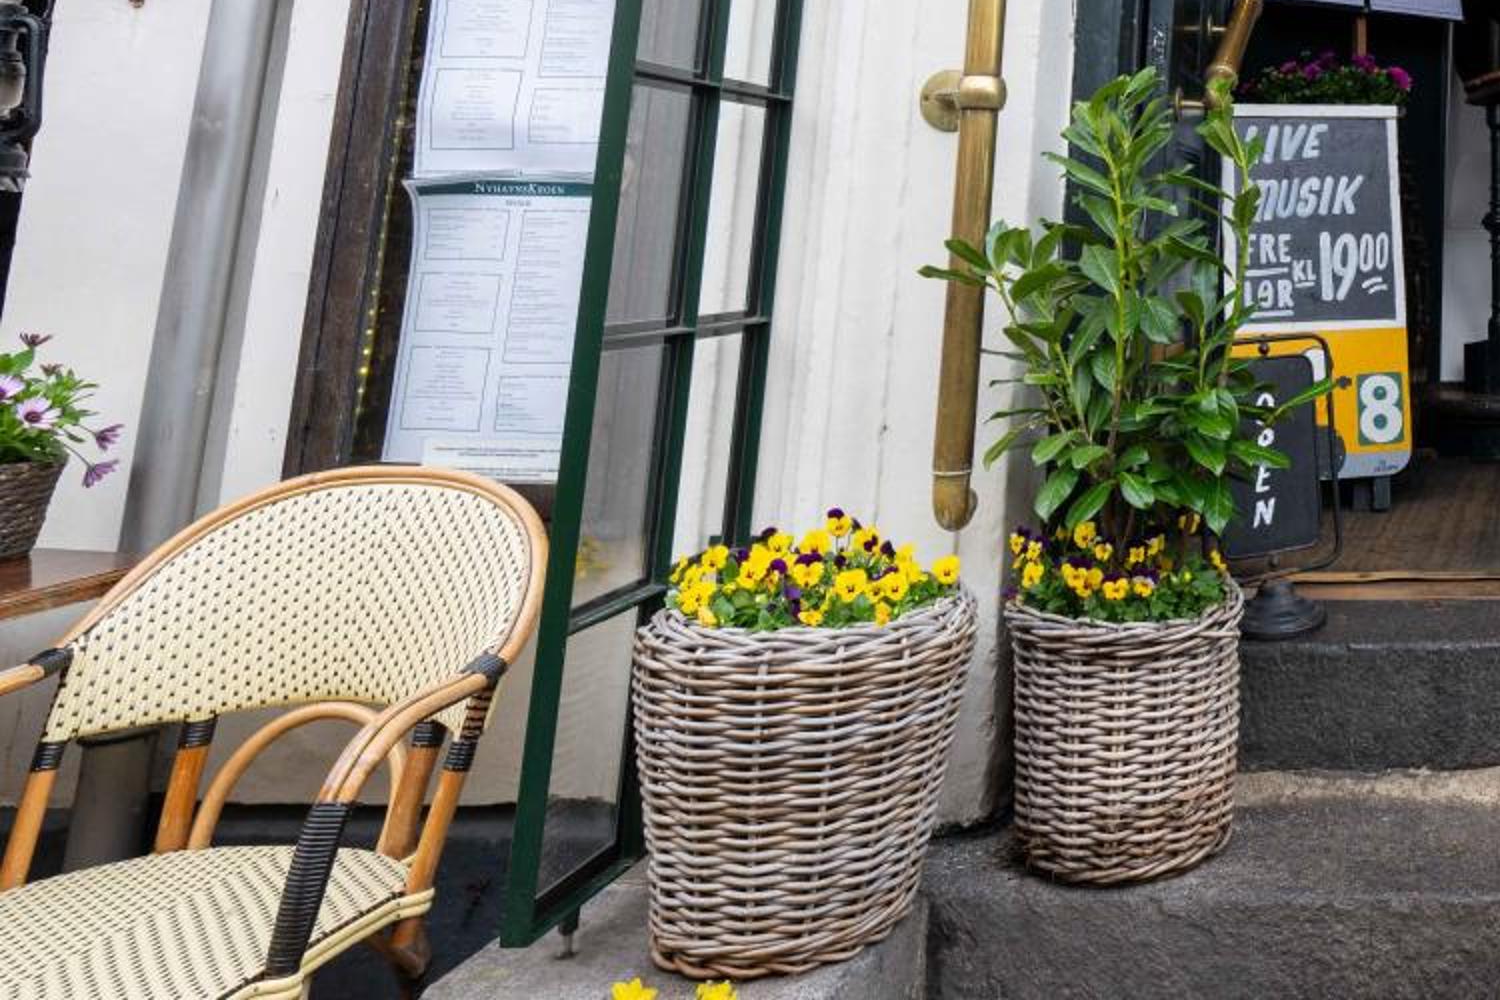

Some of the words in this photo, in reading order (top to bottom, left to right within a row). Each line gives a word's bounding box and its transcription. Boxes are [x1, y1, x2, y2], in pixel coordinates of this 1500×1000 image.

[1246, 175, 1364, 222] MUSIK
[1246, 234, 1292, 265] FRE
[1292, 259, 1317, 282] KL
[1358, 373, 1405, 445] 8
